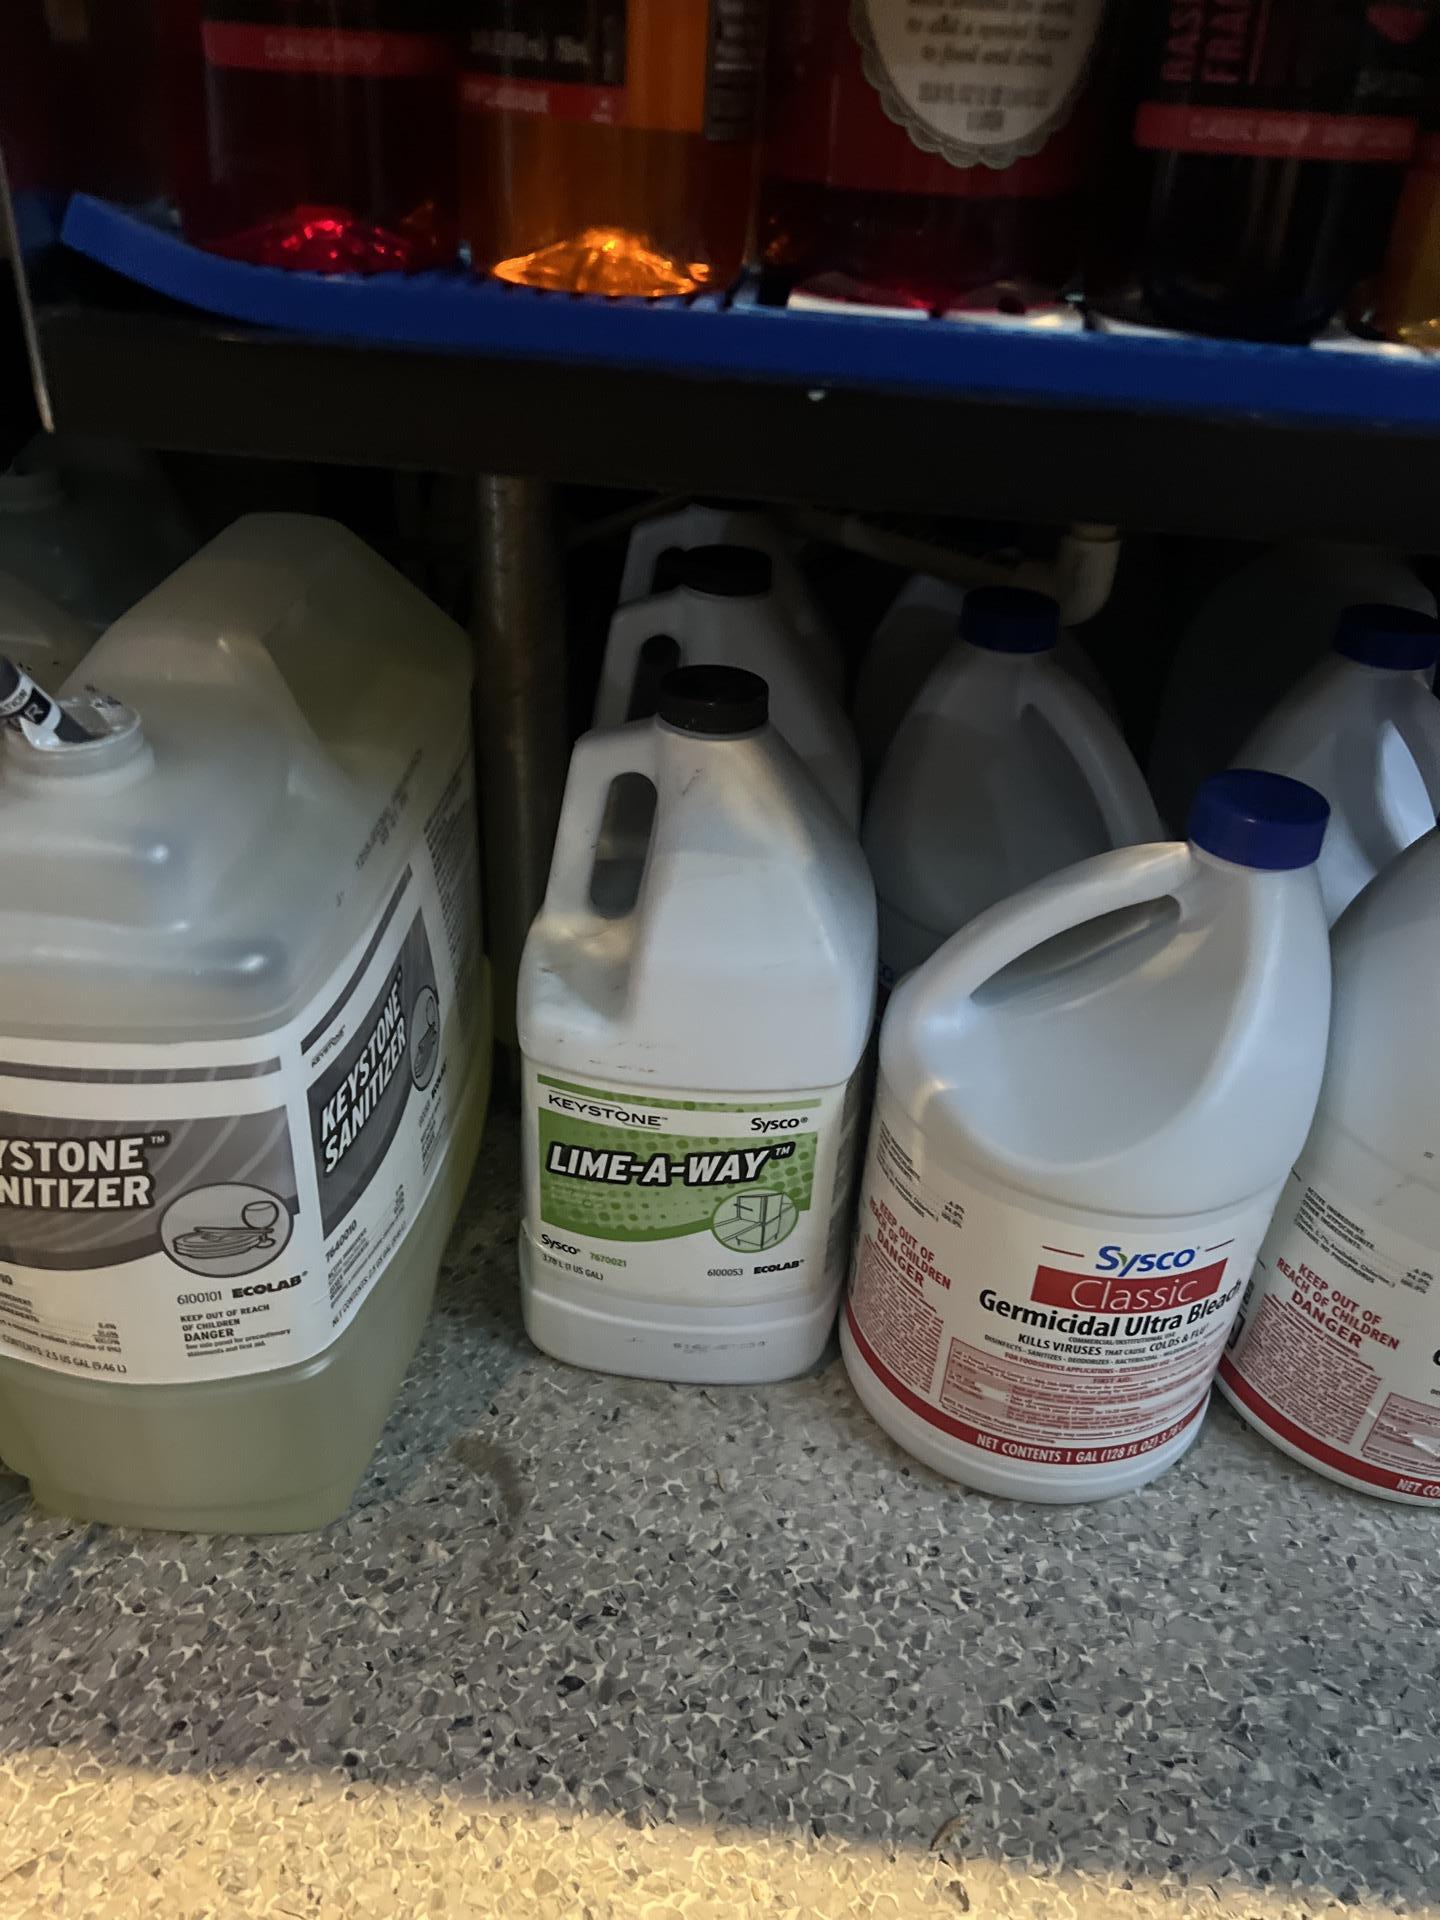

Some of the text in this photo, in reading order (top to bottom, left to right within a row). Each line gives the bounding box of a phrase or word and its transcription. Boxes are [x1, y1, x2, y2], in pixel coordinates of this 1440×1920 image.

[321, 980, 402, 1142] KEYSTONE
[325, 1017, 406, 1173] SANITIZER
[541, 1233, 578, 1255] Sysco
[877, 1228, 925, 1289] DANGER
[899, 1226, 919, 1250] OUT
[920, 1246, 936, 1264] OF
[573, 1265, 584, 1275] US
[585, 1269, 604, 1281] GAL)
[707, 1260, 801, 1277] 6100053 ECOLAB
[888, 1228, 899, 1244] OF
[900, 1243, 952, 1291] CHILDREN
[1095, 1245, 1196, 1277] Sysco
[177, 1275, 303, 1305] 6100101 ECOLAB
[1071, 1278, 1198, 1311] Classic
[1276, 1257, 1311, 1295] REACH
[1312, 1291, 1330, 1308] OF
[1332, 1306, 1400, 1351] CHILDREN
[1298, 1263, 1383, 1327] KEEP OUT OF
[180, 1304, 270, 1322] KEEP OUT OF REACH
[979, 1288, 1117, 1337] Germicidal
[1124, 1313, 1182, 1337] Ultra
[1186, 1278, 1242, 1325] Bleach
[1291, 1290, 1363, 1349] DANGER
[184, 1328, 235, 1342] DANGER
[196, 1318, 241, 1330] CHILDREN
[1018, 1333, 1050, 1349] KILLS
[1053, 1341, 1102, 1356] VIRUSES
[1123, 1347, 1146, 1356] CAUSE
[1149, 1337, 1179, 1353] COLDS
[1181, 1334, 1189, 1344] &
[1027, 1348, 1063, 1362] SANITIZES
[59, 1353, 72, 1365] US
[72, 1357, 91, 1369] GAL
[976, 1435, 998, 1451] NET
[1001, 1442, 1061, 1462] CONTENTS
[1065, 1452, 1071, 1462] 1
[1075, 1451, 1098, 1462] GAL
[1100, 1447, 1125, 1463] (128
[1127, 1445, 1139, 1458] FL
[1396, 1478, 1423, 1493] NET
